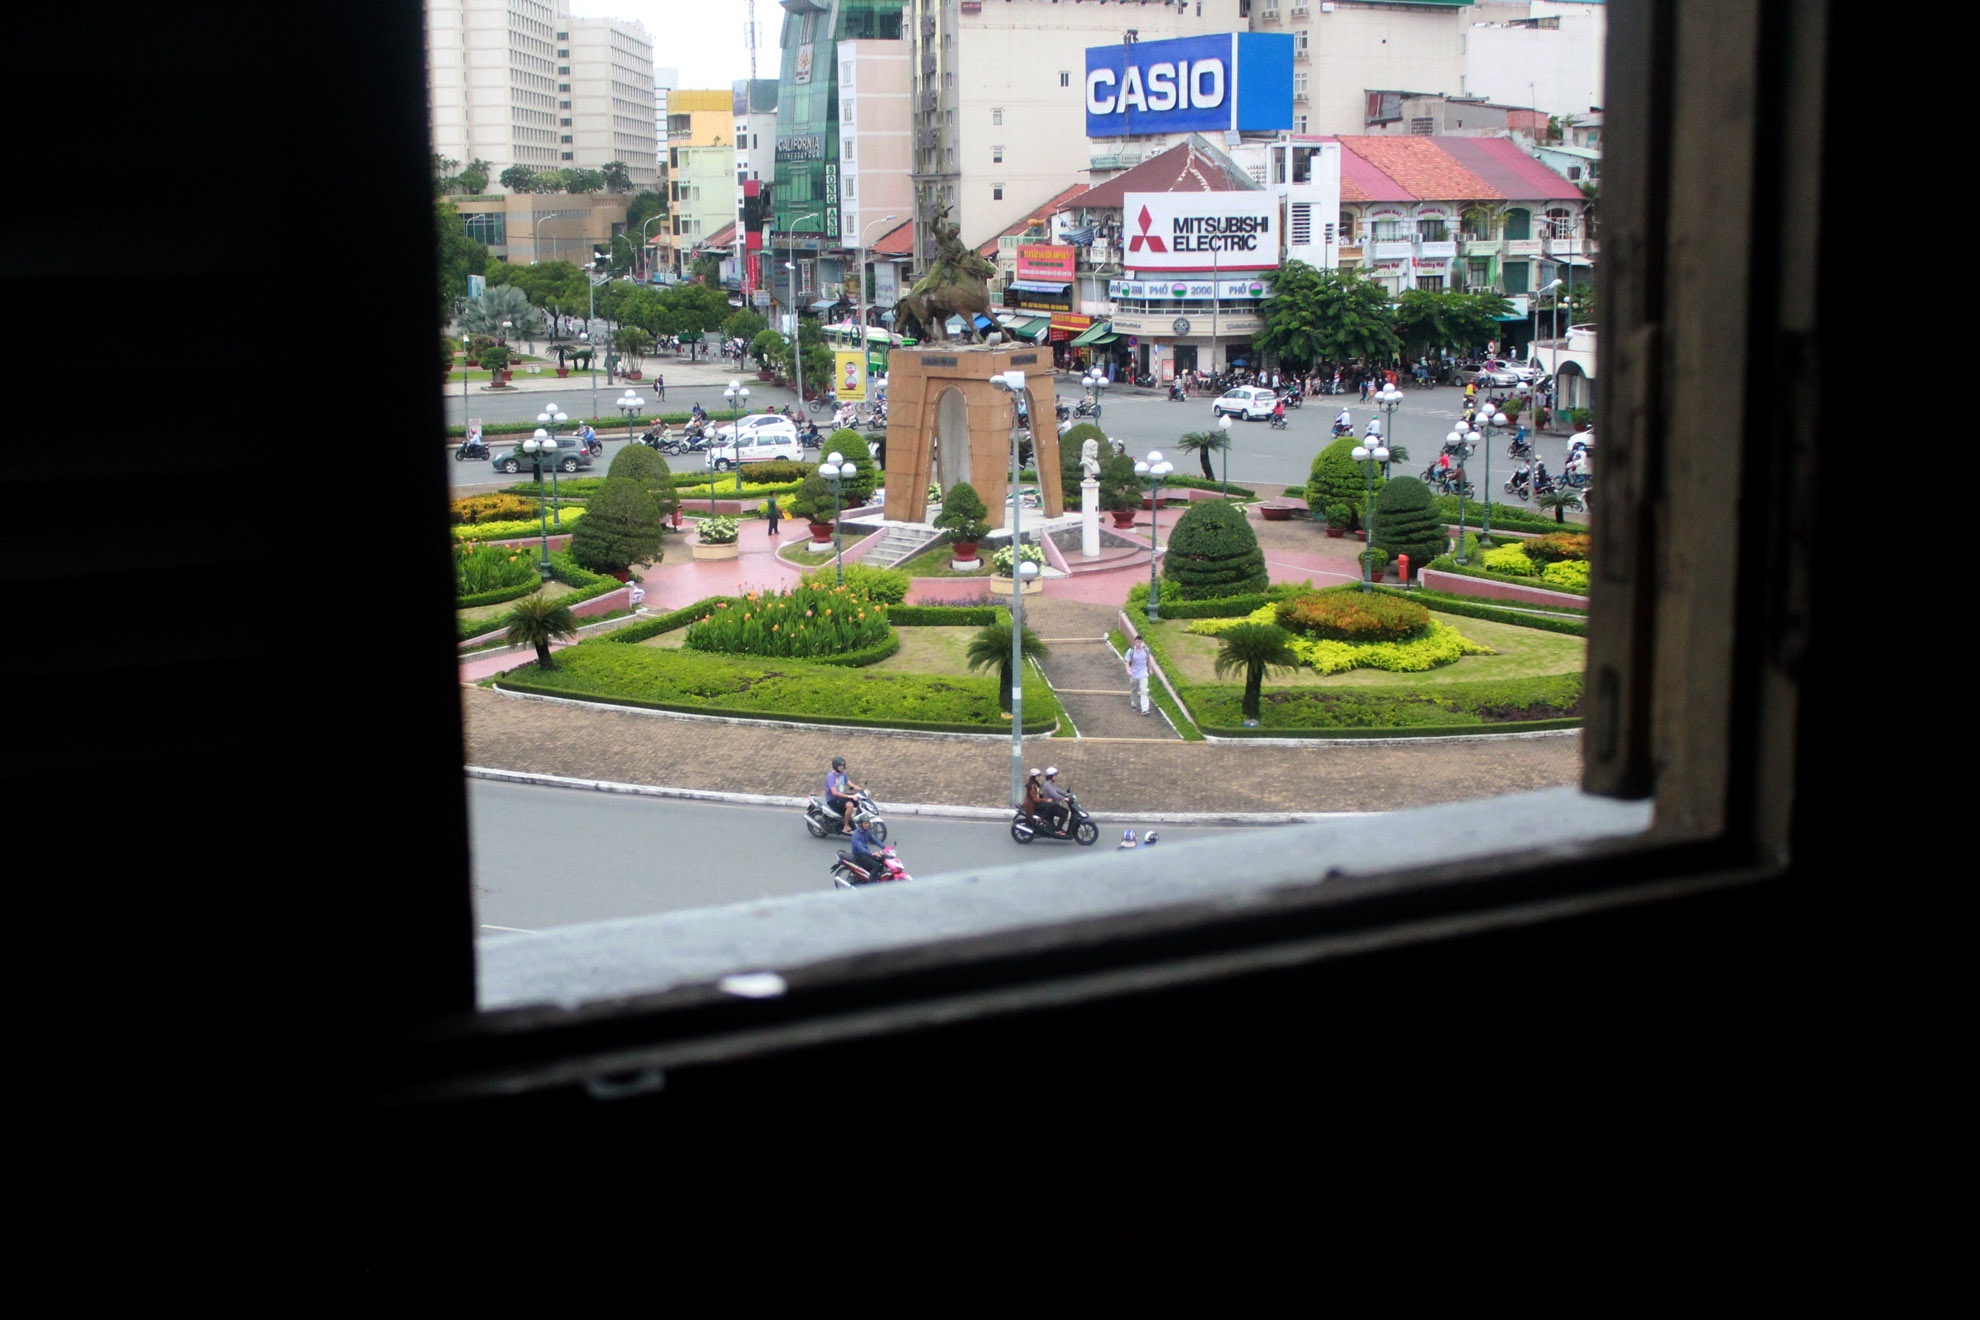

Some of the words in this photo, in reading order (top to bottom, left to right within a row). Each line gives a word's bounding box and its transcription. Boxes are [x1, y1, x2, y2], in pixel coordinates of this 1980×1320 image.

[1086, 57, 1225, 115] CASIO
[778, 136, 820, 152] CALIFORNIA
[827, 166, 836, 204] SONG
[829, 208, 837, 237] ANH
[1173, 216, 1269, 234] MITSUBISHI
[1173, 234, 1257, 251] ELECTRIC
[1191, 286, 1212, 295] 2000
